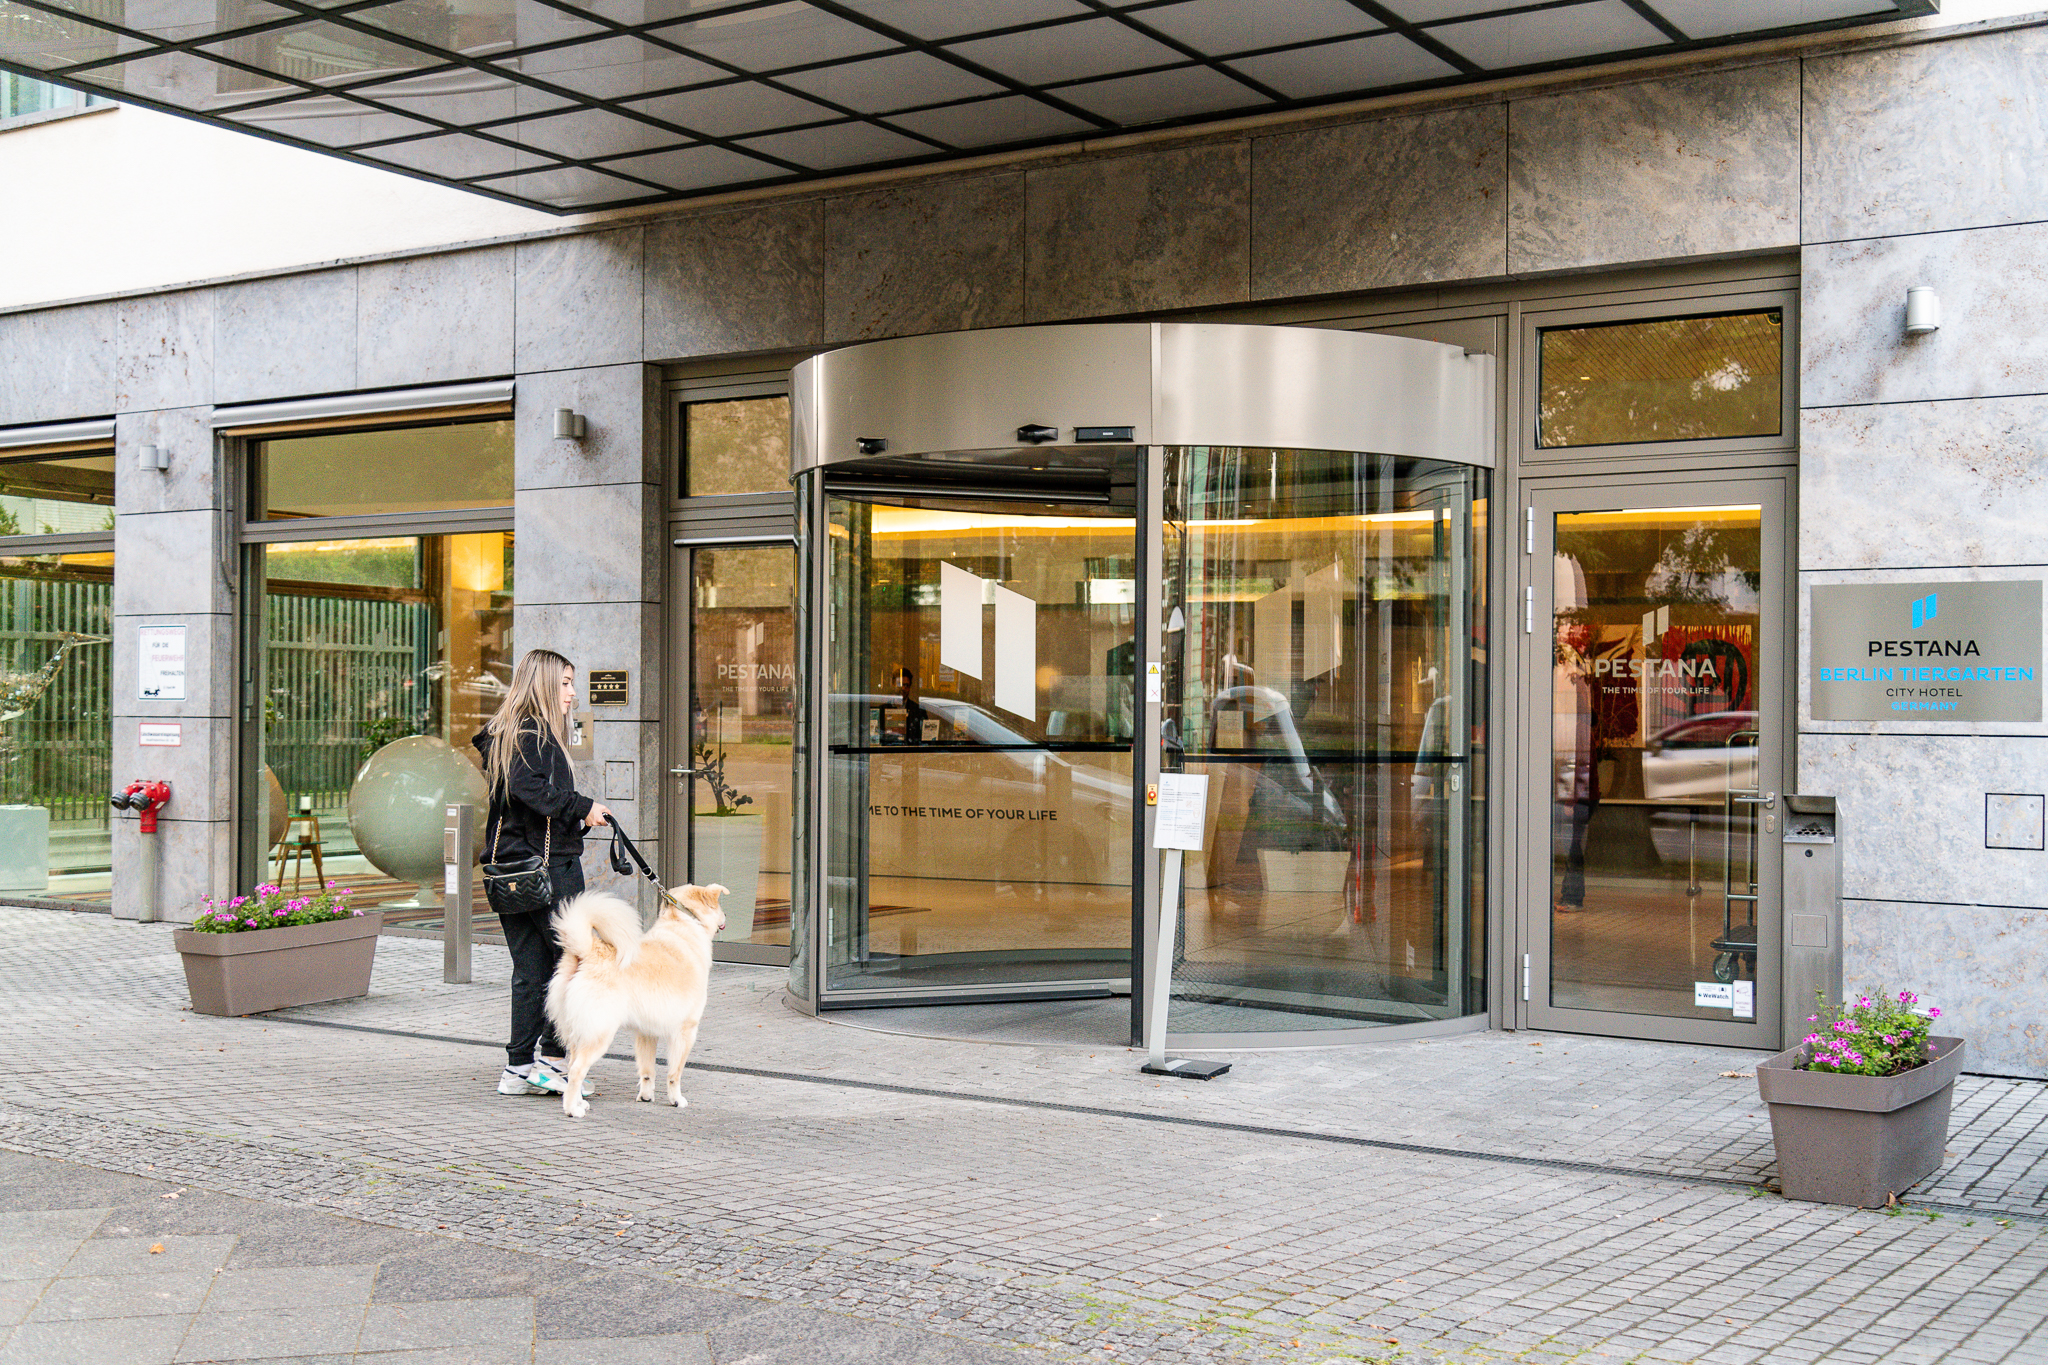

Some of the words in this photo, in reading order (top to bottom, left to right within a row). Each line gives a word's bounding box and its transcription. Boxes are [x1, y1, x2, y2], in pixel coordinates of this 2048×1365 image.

[1868, 640, 1981, 657] PESTANA
[151, 654, 185, 662] FEUERWEHR
[717, 664, 793, 680] PESTANA
[1595, 658, 1717, 678] PESTANA
[1820, 667, 1894, 682] BERLIN
[1899, 667, 2034, 682] TIERGARTEN
[1602, 686, 1620, 694] THE
[1622, 686, 1644, 695] TIME
[1661, 687, 1687, 695] YOUR
[1689, 687, 1710, 695] LIFE
[1886, 688, 1915, 697] CITY
[1919, 688, 1963, 697] HOTEL
[1891, 701, 1958, 711] GERMANY
[884, 806, 899, 816] TO
[901, 806, 927, 817] THE
[929, 807, 962, 818] TIME
[965, 808, 984, 819] OF
[986, 808, 1025, 820] YOUR
[1028, 810, 1058, 821] LIFE
